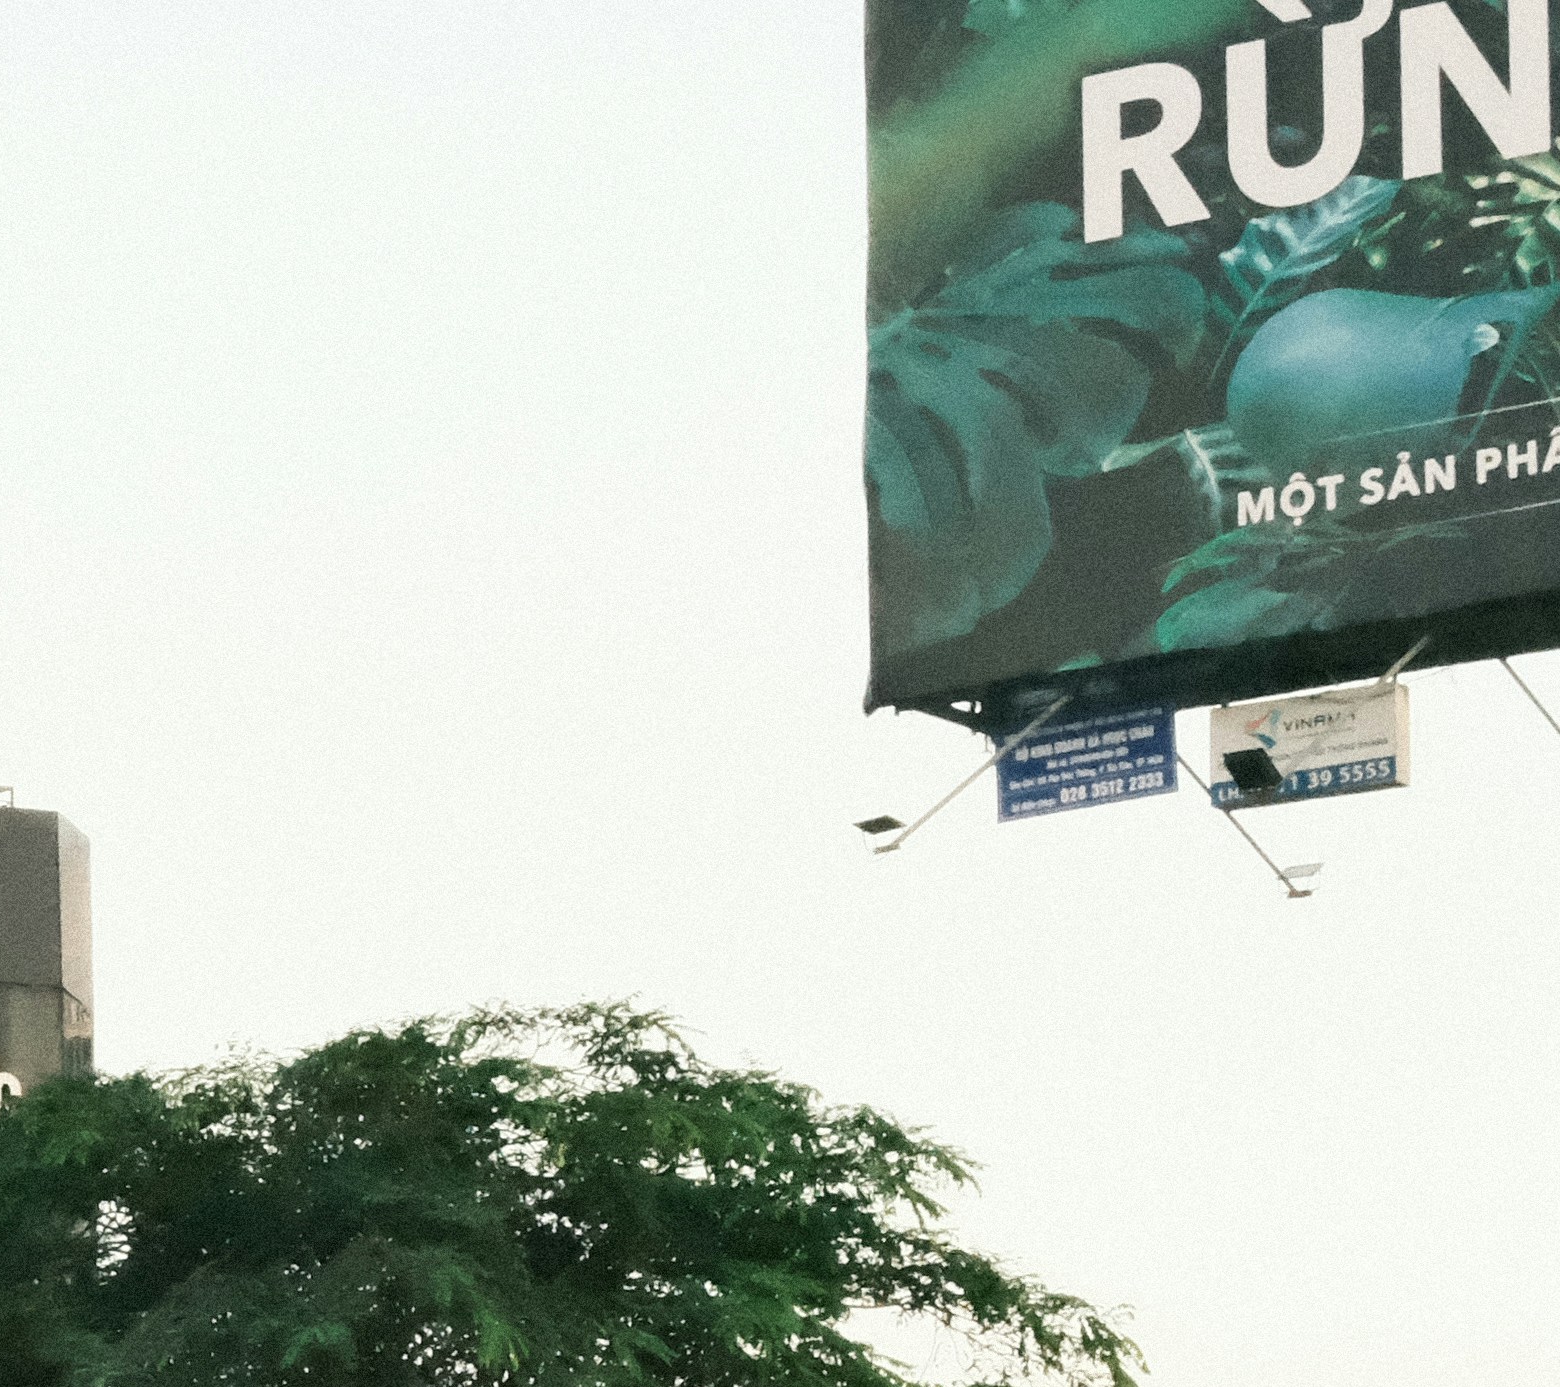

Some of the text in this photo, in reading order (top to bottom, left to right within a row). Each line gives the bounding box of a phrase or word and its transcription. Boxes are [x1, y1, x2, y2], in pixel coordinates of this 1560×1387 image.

[1237, 471, 1345, 527] MỘT
[1359, 451, 1456, 505] SẢN
[1308, 770, 1333, 790] 39
[1339, 760, 1392, 785] 5555
